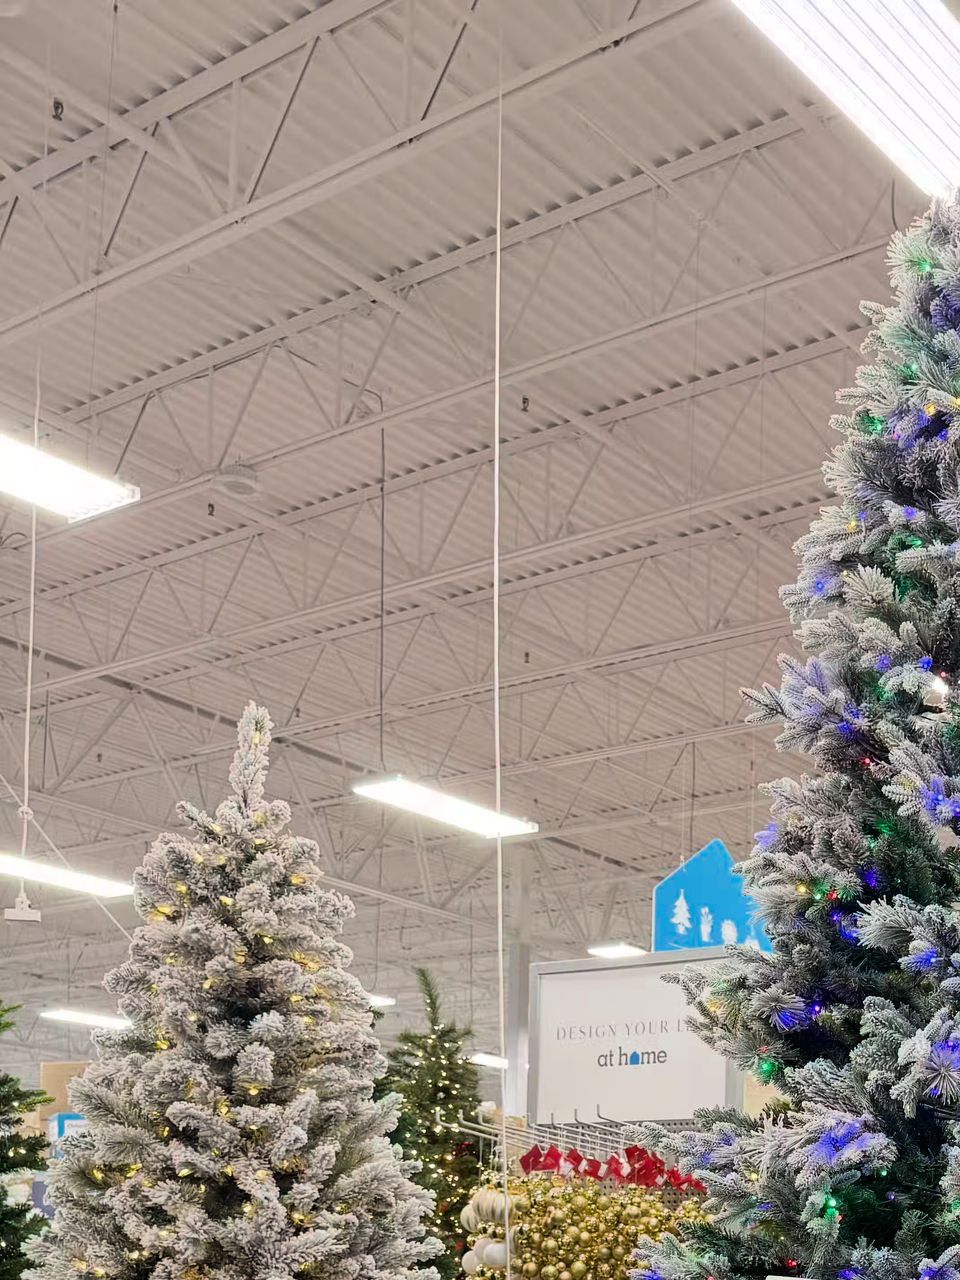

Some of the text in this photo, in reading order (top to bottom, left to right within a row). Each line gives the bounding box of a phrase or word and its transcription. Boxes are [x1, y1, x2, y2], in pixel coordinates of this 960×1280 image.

[556, 1023, 617, 1041] DESIGN
[625, 1019, 669, 1037] YOUR
[597, 1046, 668, 1067] at home
